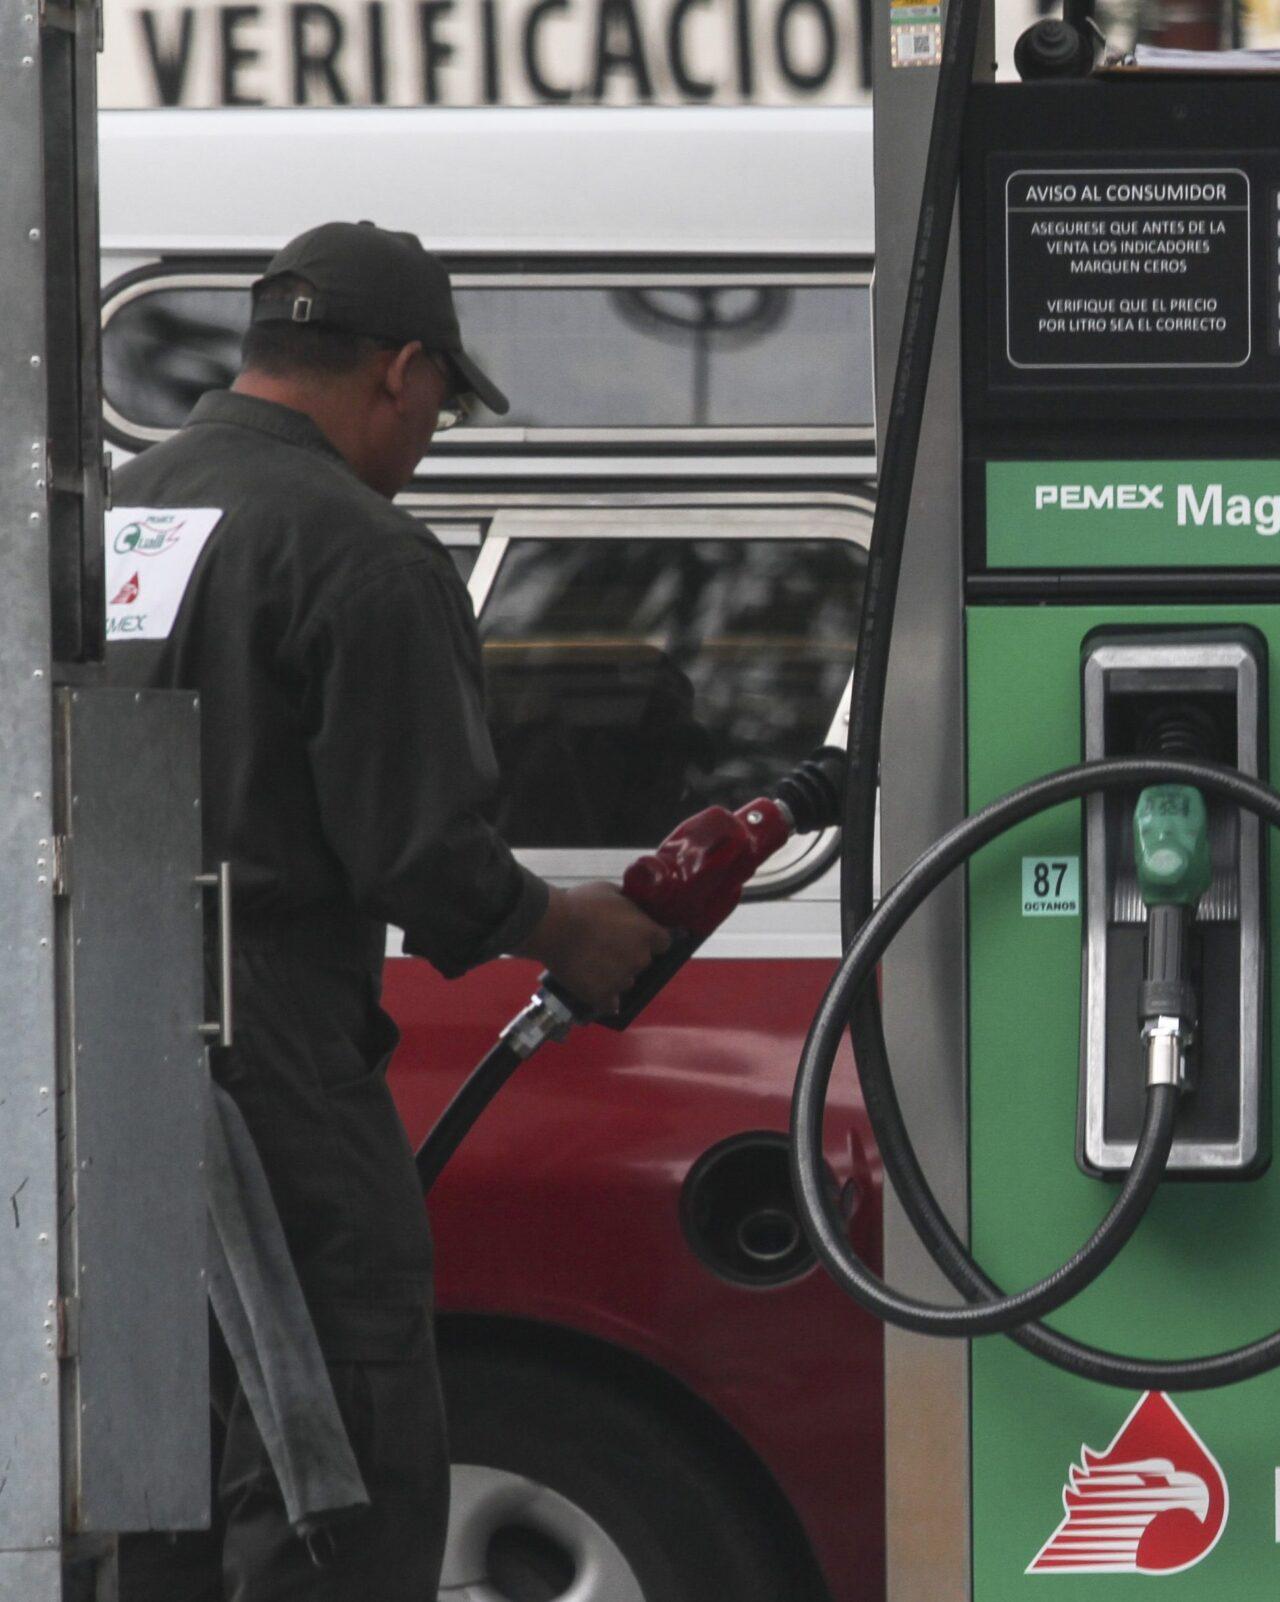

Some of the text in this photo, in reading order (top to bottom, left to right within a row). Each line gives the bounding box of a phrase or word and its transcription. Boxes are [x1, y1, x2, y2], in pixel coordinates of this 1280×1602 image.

[1026, 183, 1227, 201] AVISO AL CONSUMIDOR
[1031, 220, 1226, 236] ASEGURESE QUE ANTES DE LA
[1047, 240, 1210, 255] VENTA LOS INDICADORES
[1070, 259, 1188, 275] MARQUEN CEROS
[1047, 298, 1217, 314] VERIFIQUE QUE EL PRECIO
[1038, 317, 1227, 332] POR LITRO SEA EL CORRECTO
[1036, 484, 1164, 510] PEMEX
[1033, 863, 1068, 897] 87
[1024, 902, 1076, 911] OCTANOS
